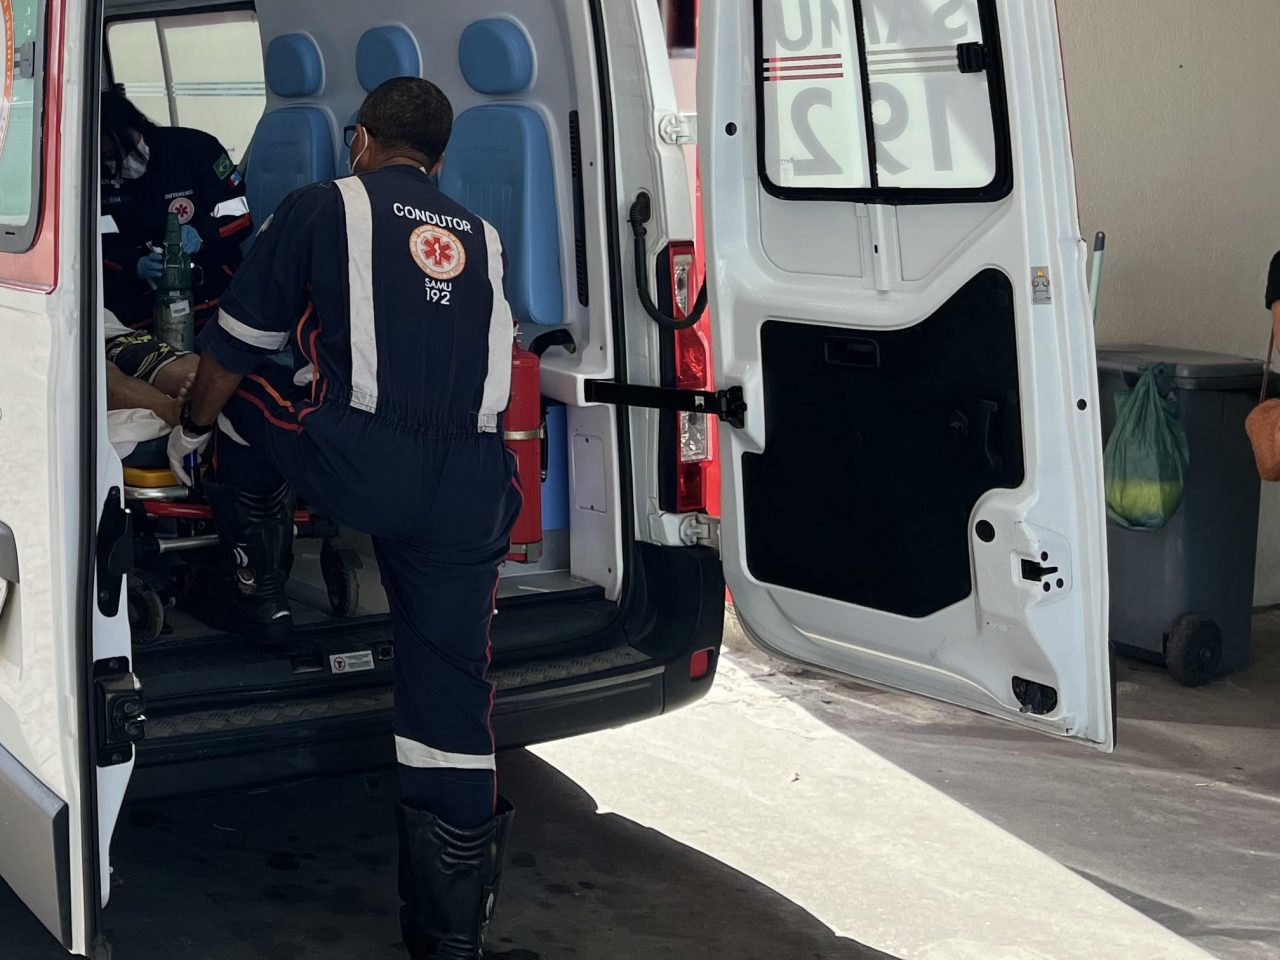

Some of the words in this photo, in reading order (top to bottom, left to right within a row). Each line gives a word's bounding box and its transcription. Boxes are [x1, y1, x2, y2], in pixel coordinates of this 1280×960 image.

[393, 202, 473, 233] CONDUTOR
[424, 278, 452, 291] SAMU
[425, 287, 451, 305] 192
